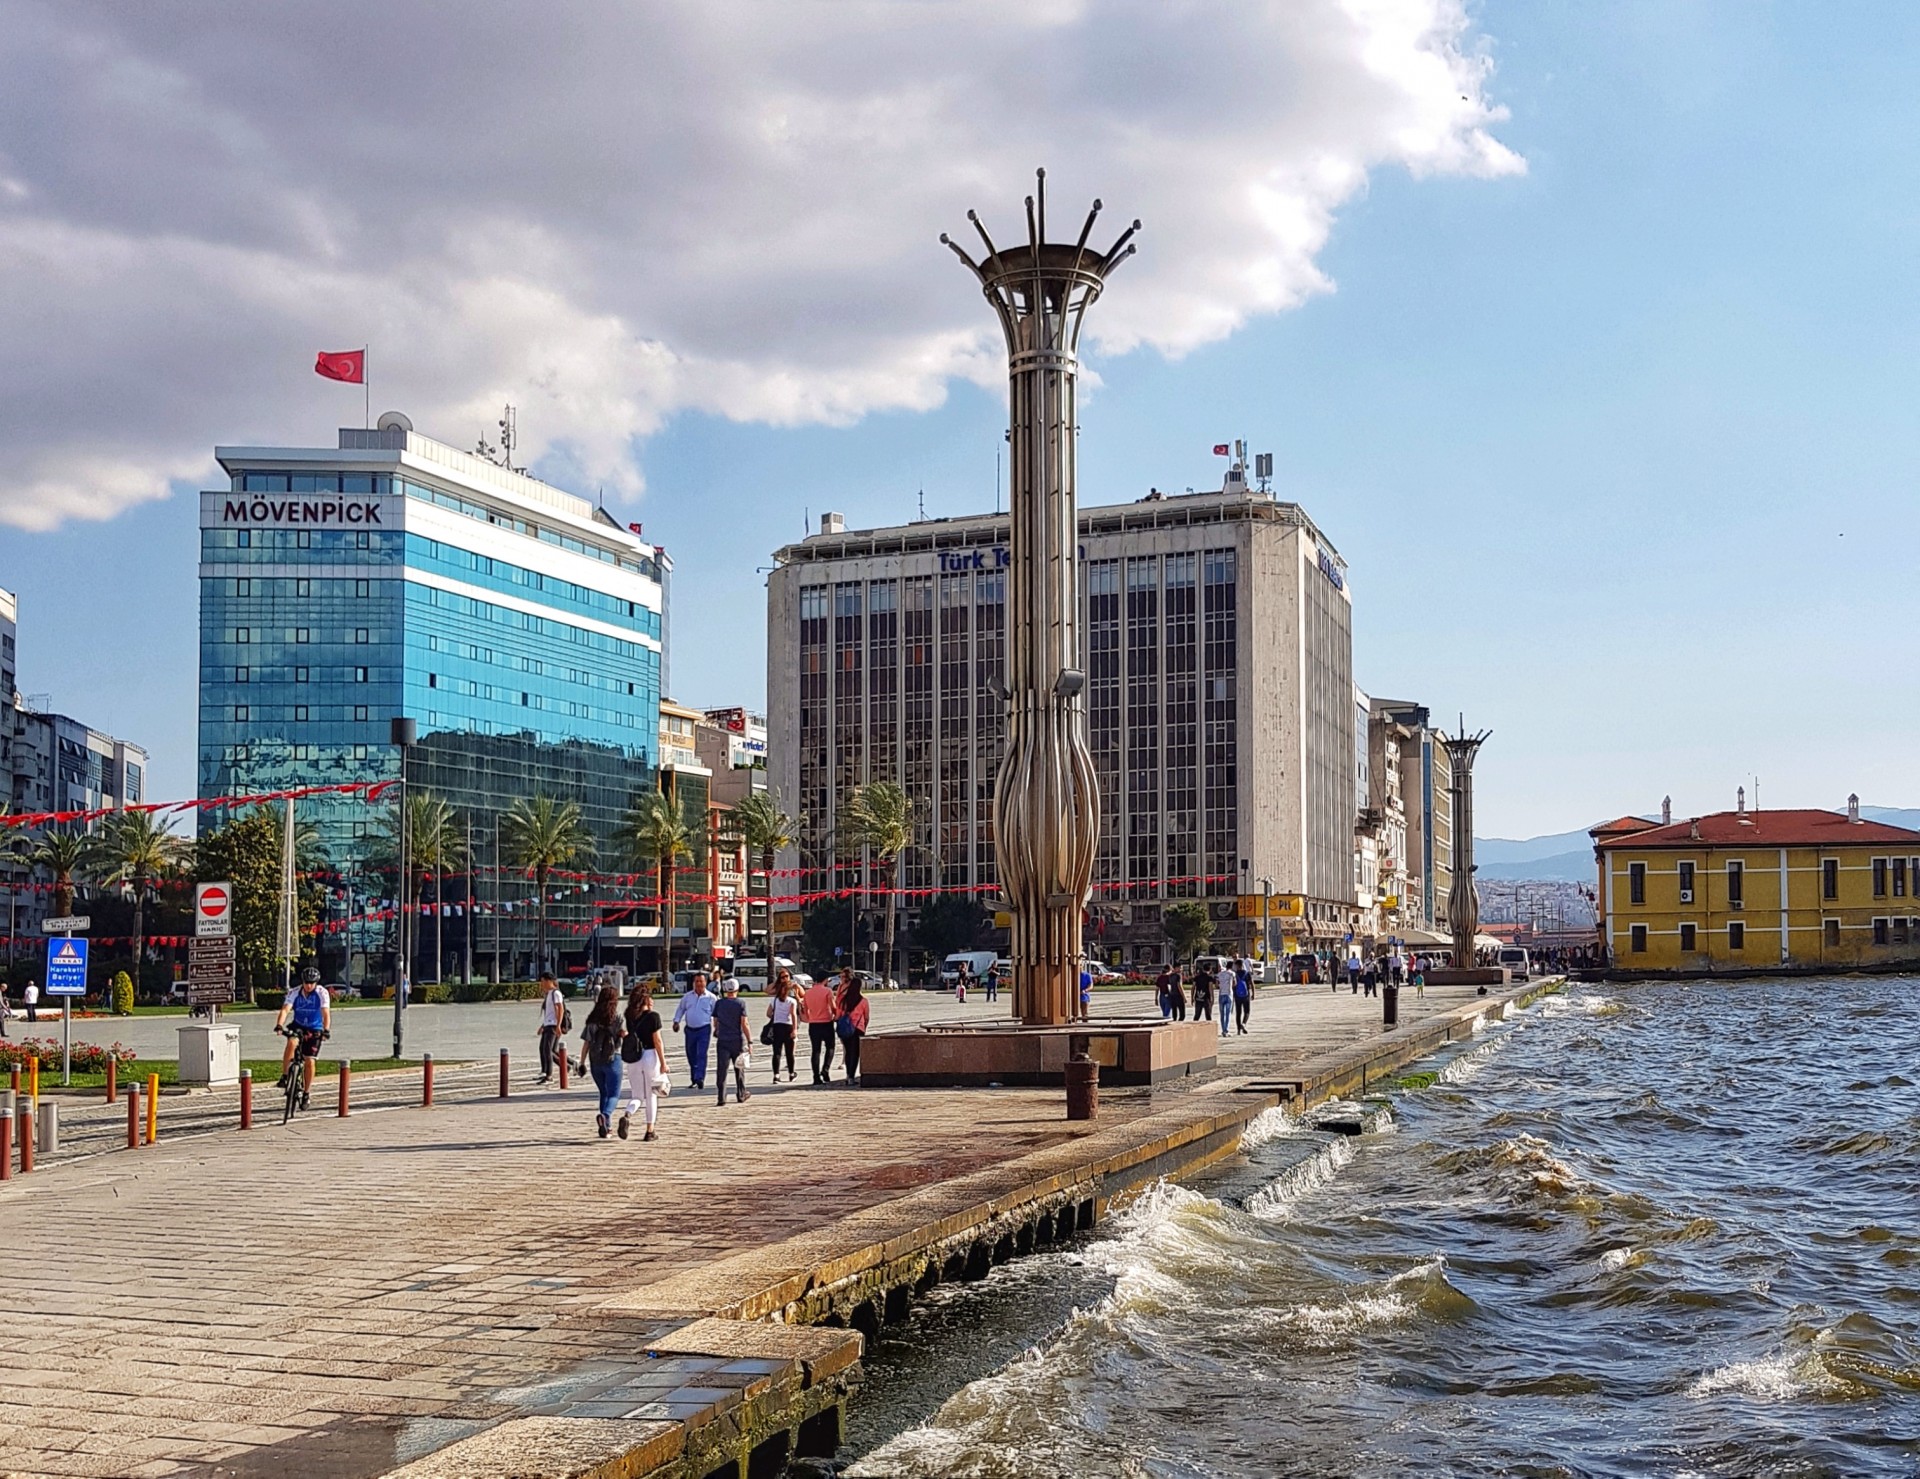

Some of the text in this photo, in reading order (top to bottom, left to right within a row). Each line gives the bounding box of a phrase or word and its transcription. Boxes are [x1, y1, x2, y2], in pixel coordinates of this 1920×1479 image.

[223, 494, 382, 524] MÖVENPİCK
[937, 549, 985, 572] Türk
[52, 973, 81, 981] Bariyer
